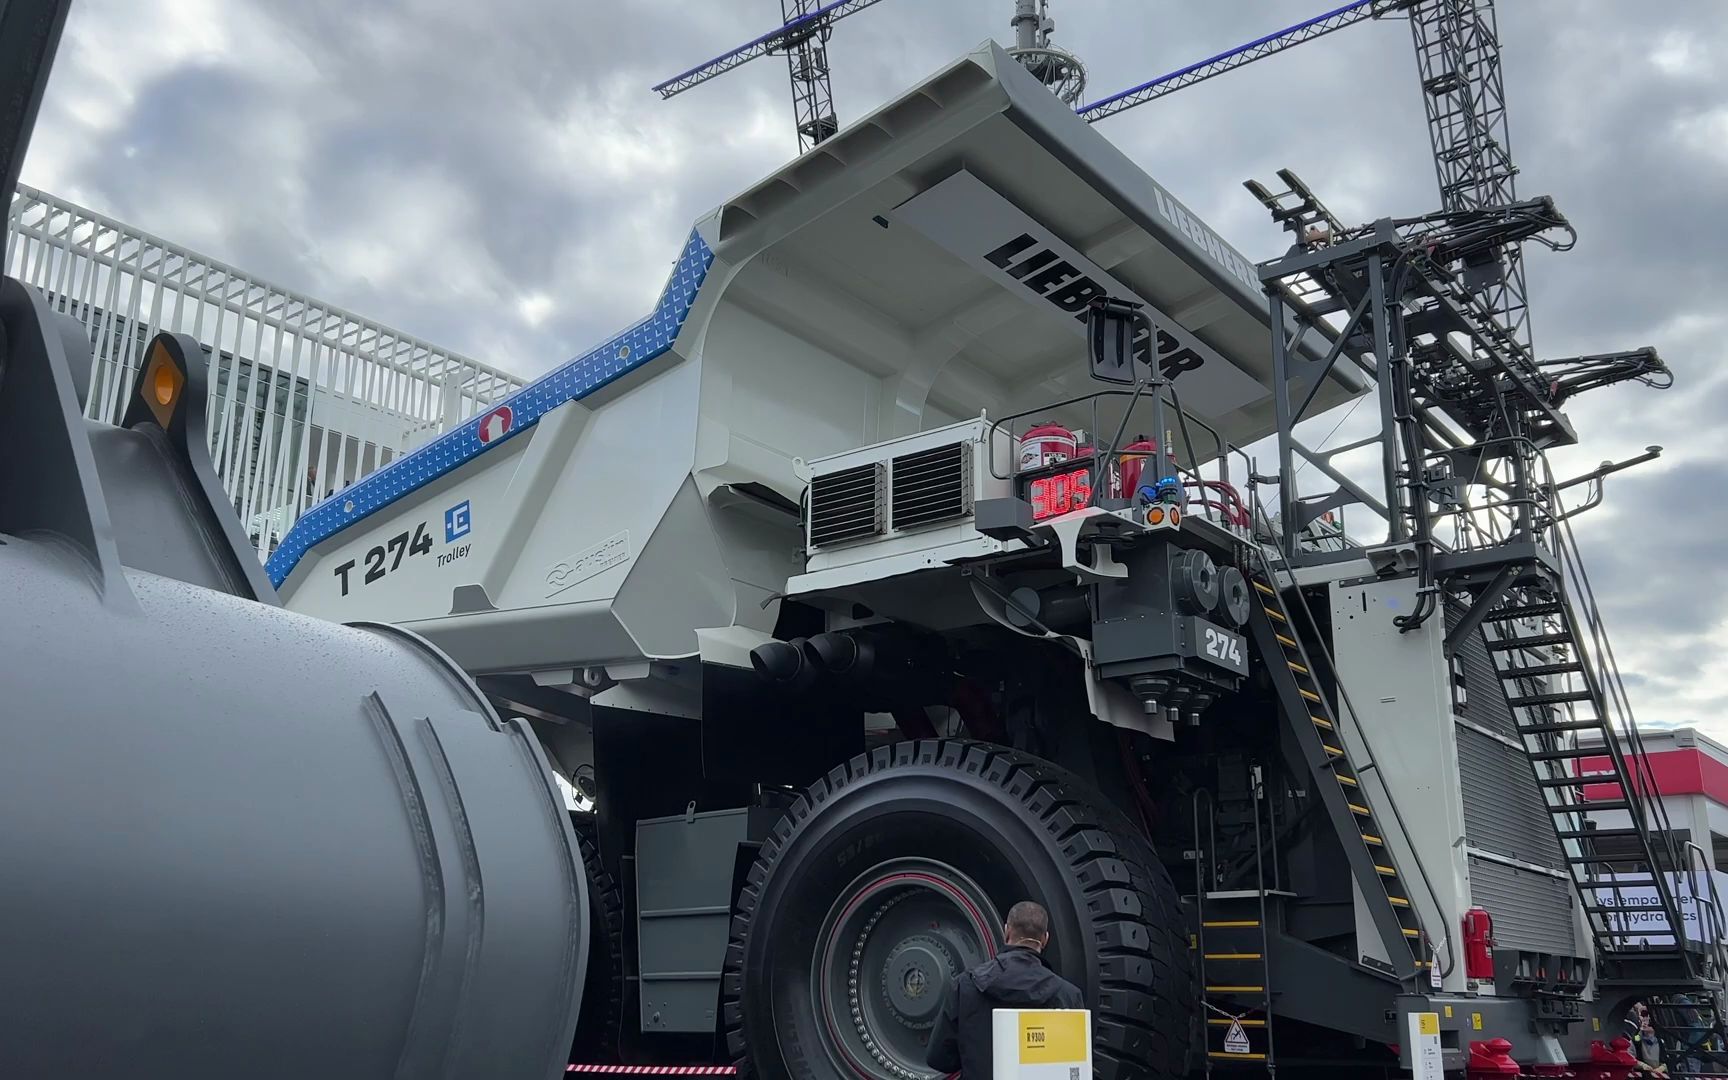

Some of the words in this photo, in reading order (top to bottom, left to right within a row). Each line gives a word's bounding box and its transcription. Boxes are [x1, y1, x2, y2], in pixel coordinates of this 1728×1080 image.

[1153, 187, 1261, 295] LIEBHERR
[984, 233, 1205, 381] LIEBRR
[1031, 469, 1091, 519] 305
[334, 559, 356, 597] T
[365, 521, 432, 585] 274
[437, 544, 471, 568] Trolley
[1205, 628, 1241, 666] 274
[1624, 911, 1696, 925] ydracs
[1027, 1032, 1031, 1042] R
[1031, 1032, 1045, 1042] 9300
